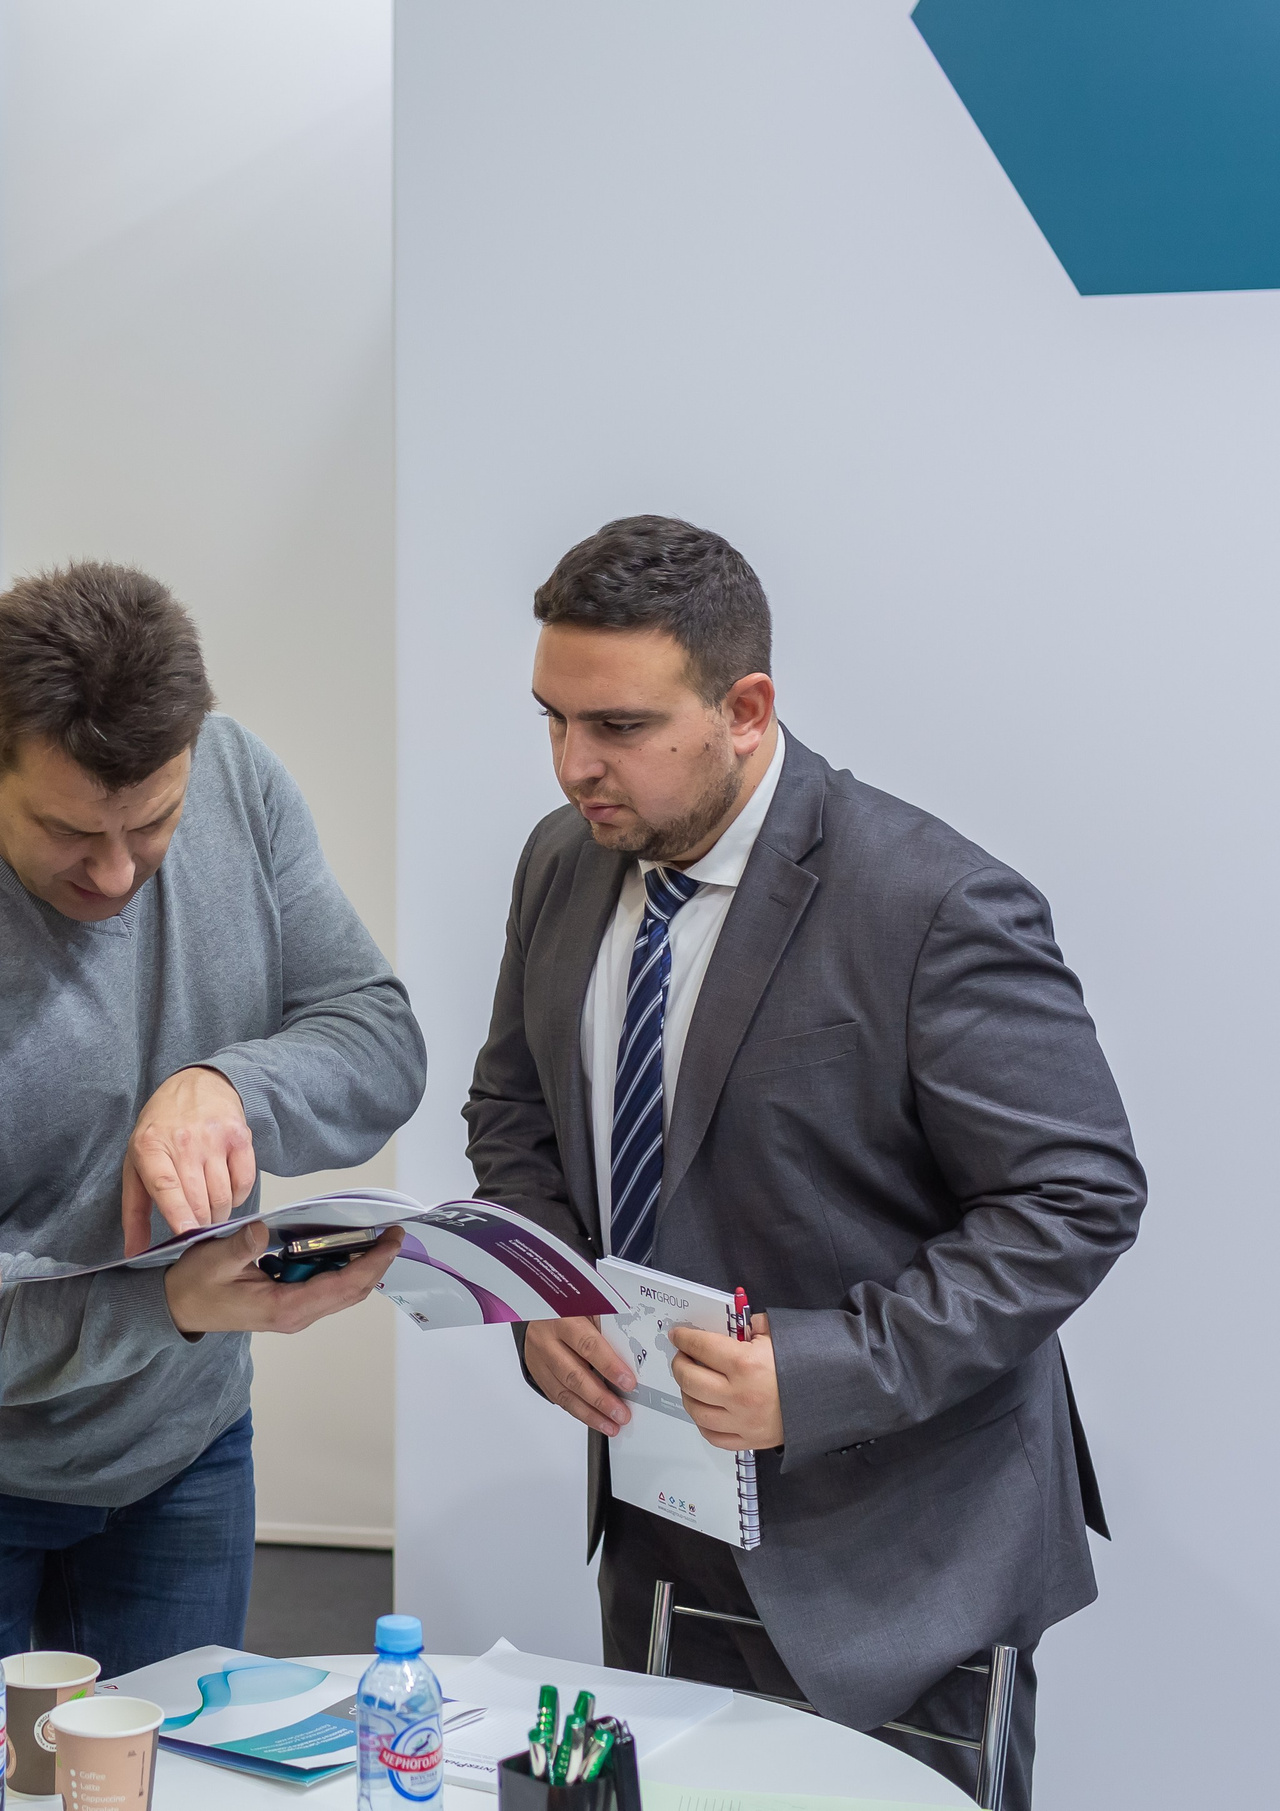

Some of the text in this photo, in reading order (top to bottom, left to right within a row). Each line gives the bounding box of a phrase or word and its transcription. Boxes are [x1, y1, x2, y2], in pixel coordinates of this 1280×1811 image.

[640, 1285, 690, 1310] PATGROUP
[382, 1748, 442, 1770] ЧЕРНОГОЛО
[80, 1770, 106, 1780] Coffee
[80, 1782, 100, 1791] Latte
[81, 1793, 126, 1804] Cappuccino
